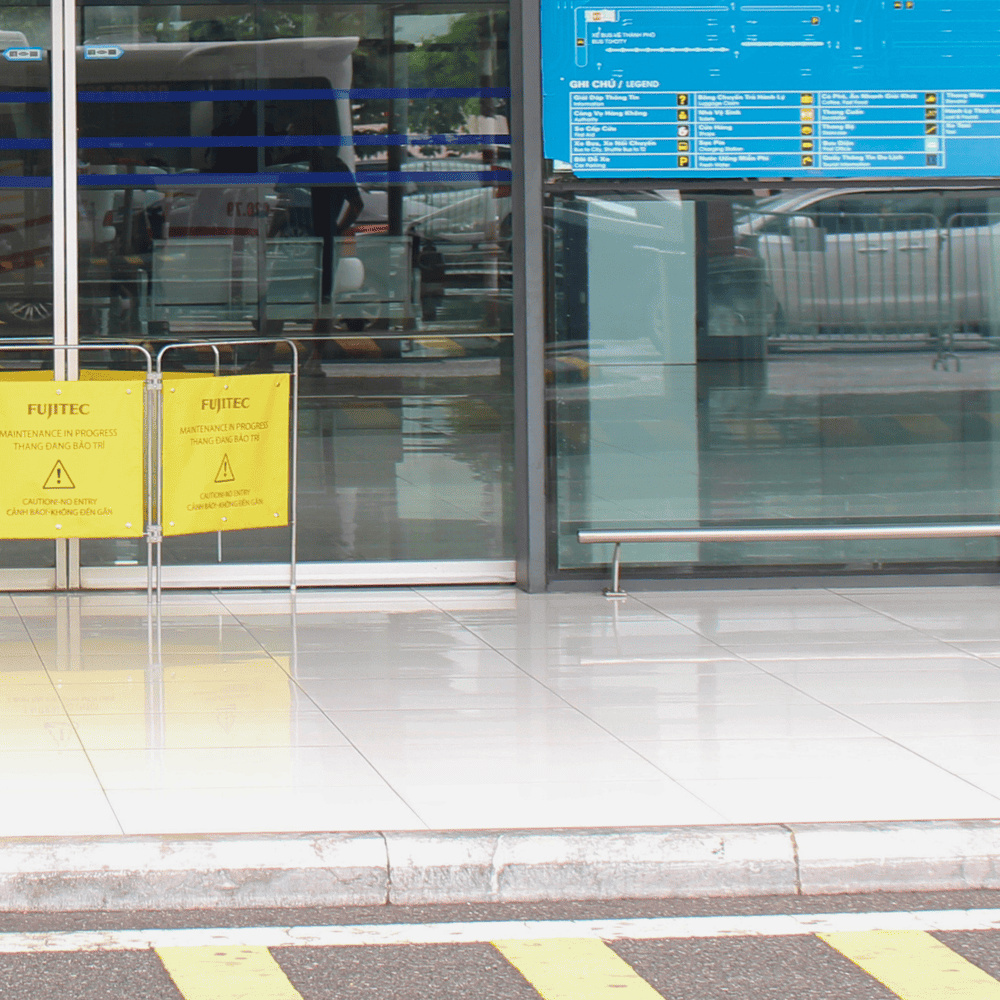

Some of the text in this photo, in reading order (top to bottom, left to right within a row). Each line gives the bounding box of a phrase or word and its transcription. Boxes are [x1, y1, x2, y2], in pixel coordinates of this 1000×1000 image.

[569, 80, 590, 88] GHI
[591, 78, 616, 88] CHÚ
[626, 80, 660, 88] LEGEND
[201, 397, 250, 414] FUJITEC
[27, 403, 90, 420] FUJITEC
[179, 420, 269, 435] MAINTENANCE IN PROGRESS
[0, 429, 118, 438] MAINTENANCE IN PROGRESS
[13, 442, 44, 450] THANG
[45, 442, 71, 450] ĐANG
[73, 440, 91, 450] BẢO
[190, 436, 214, 446] THANG
